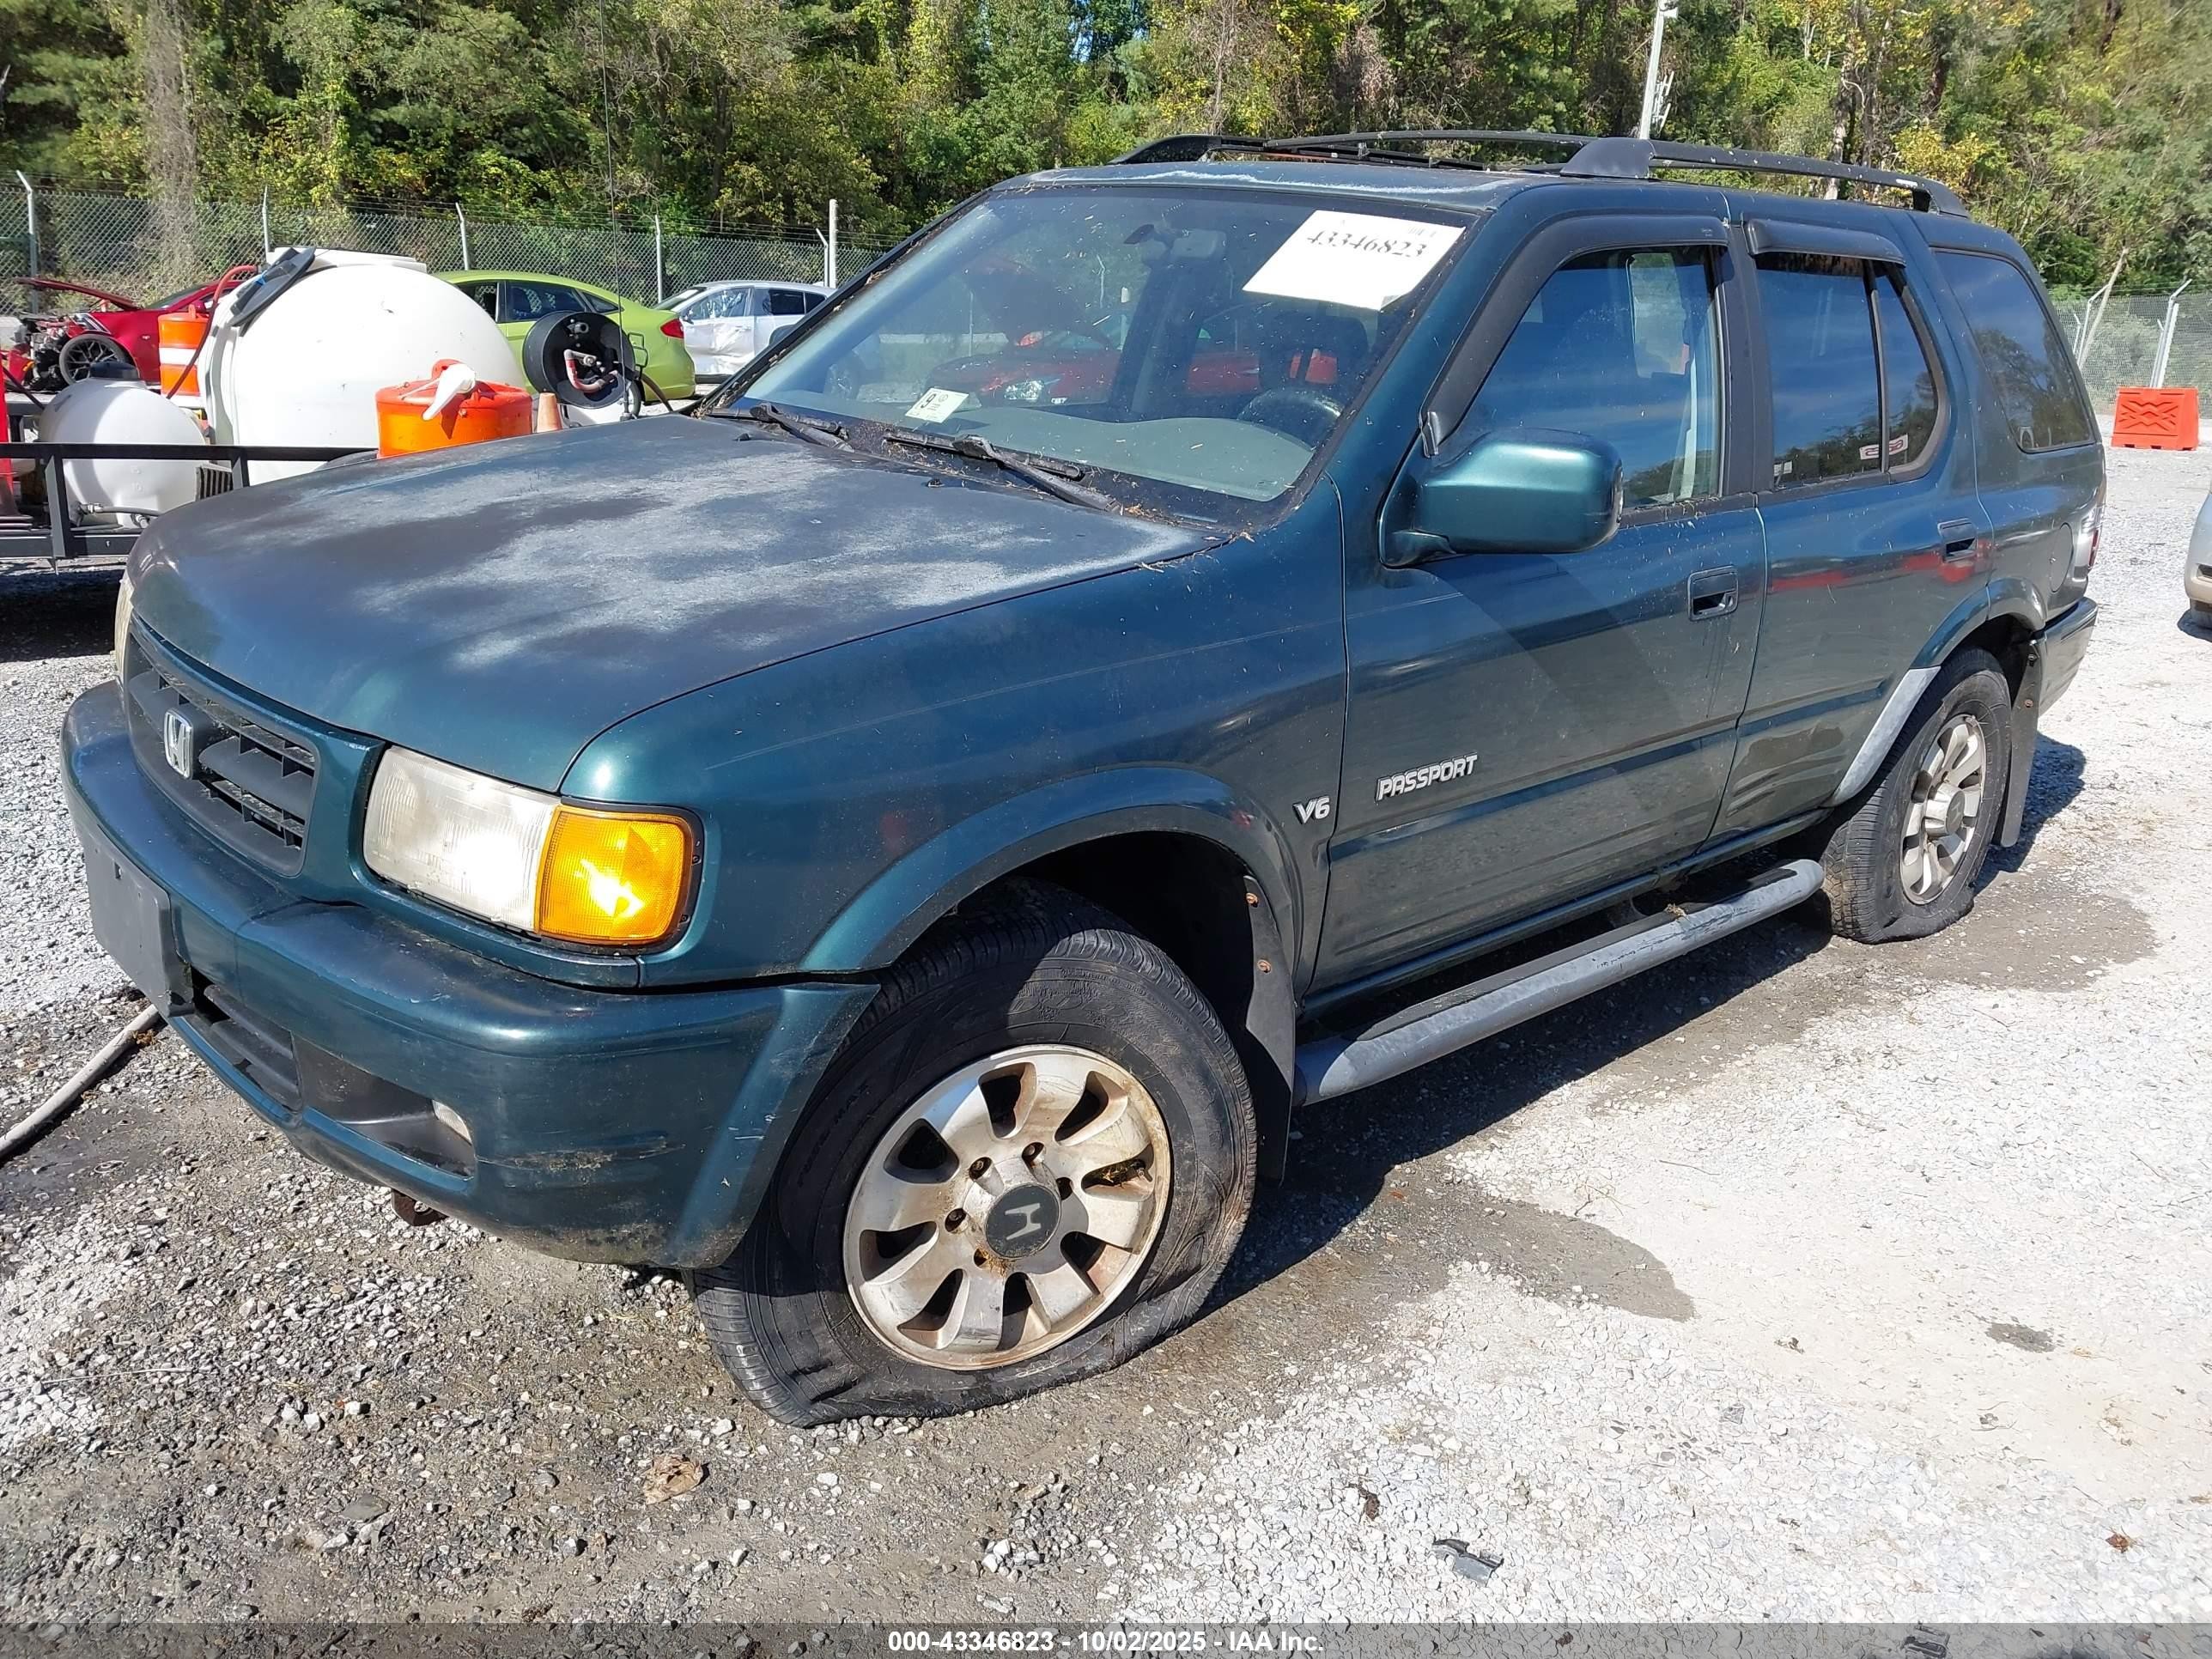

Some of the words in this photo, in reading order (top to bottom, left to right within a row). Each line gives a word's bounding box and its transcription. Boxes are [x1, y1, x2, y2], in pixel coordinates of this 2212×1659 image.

[1307, 230, 1427, 258] 43346823
[1376, 753, 1478, 801] PASSPORT
[1293, 796, 1331, 824] V6
